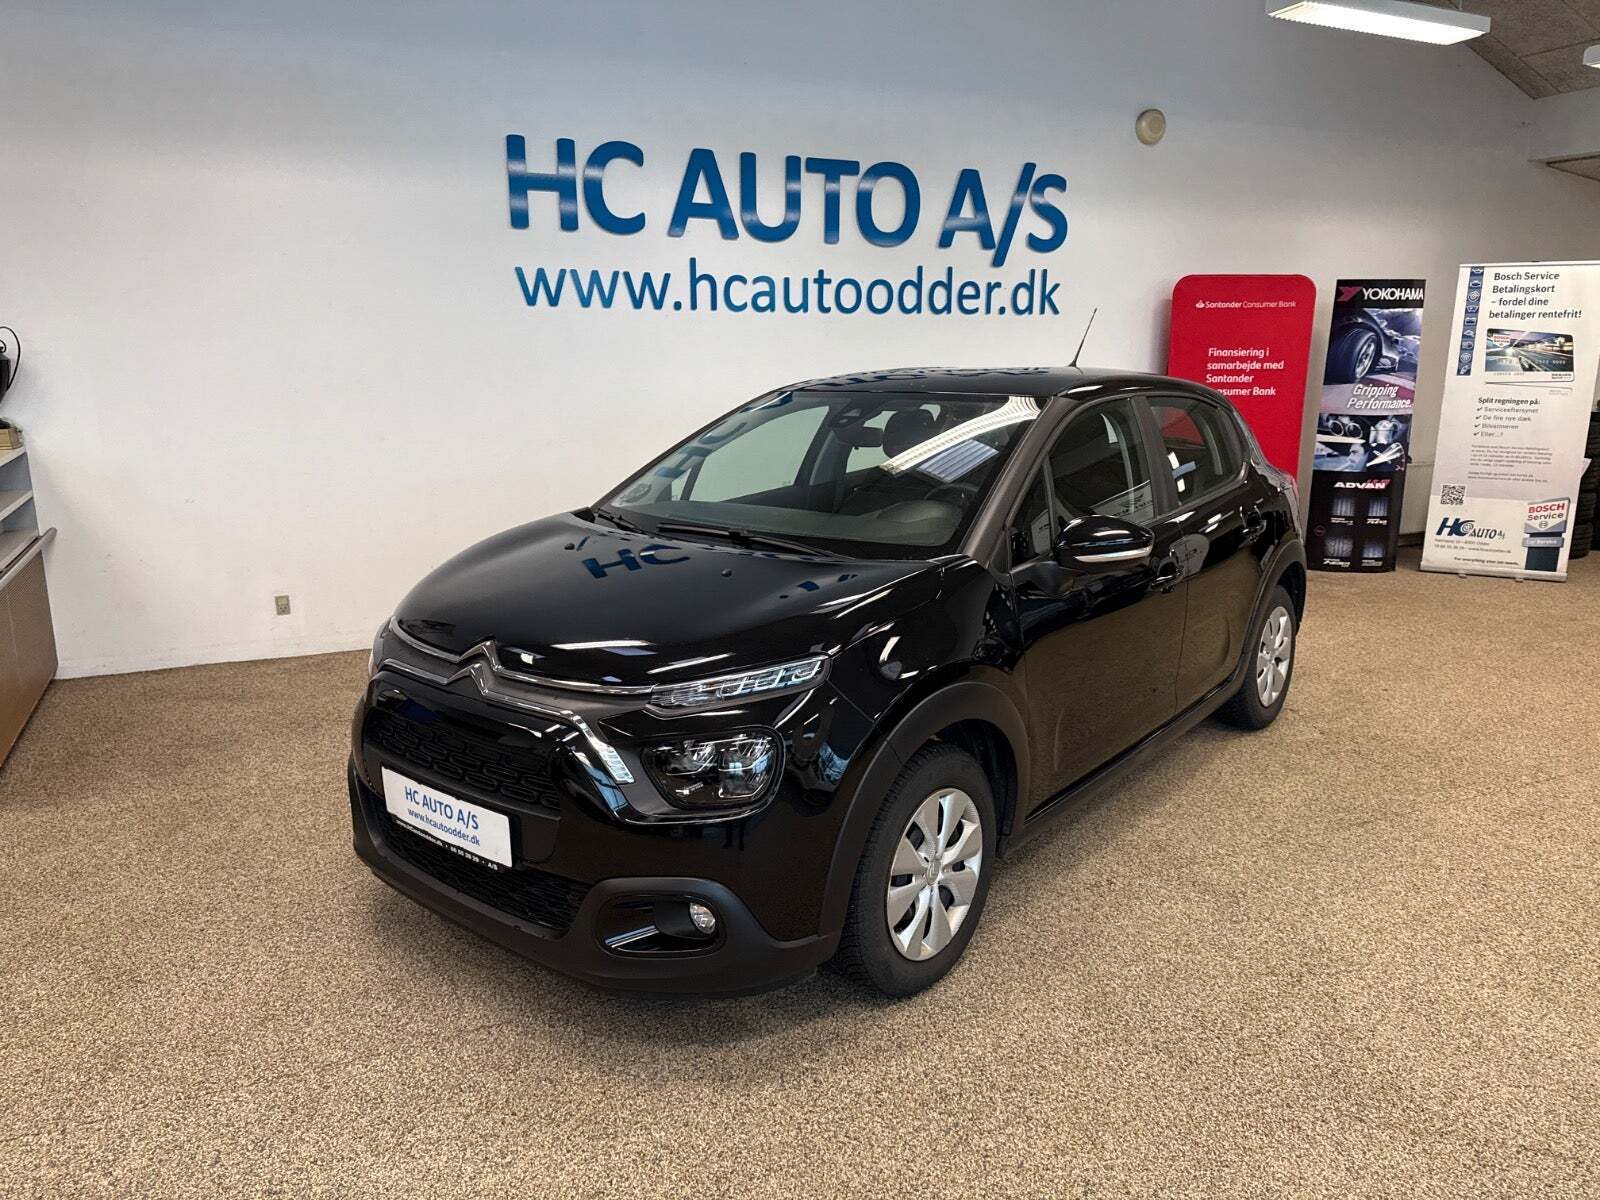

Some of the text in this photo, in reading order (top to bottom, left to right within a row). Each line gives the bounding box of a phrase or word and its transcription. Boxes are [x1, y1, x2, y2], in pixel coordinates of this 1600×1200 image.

[506, 134, 1068, 267] HC AUTO A/S
[1494, 271, 1560, 281] Bosch Service
[515, 257, 1061, 316] www.hcautoodder.dk
[1492, 284, 1555, 295] Betalingskort
[1362, 287, 1424, 300] YOKOHAMA
[1205, 301, 1242, 309] Santander
[1278, 300, 1297, 308] Bank
[1498, 297, 1527, 306] fordel
[1528, 297, 1549, 306] dine
[1489, 309, 1582, 320] betalinger rentefrit!
[1208, 347, 1265, 359] Finansiering
[1207, 360, 1285, 372] samarbejde med
[1206, 373, 1254, 383] Santander
[1252, 386, 1277, 396] Bank
[1353, 383, 1400, 398] Gripping
[1346, 397, 1414, 410] Performance.
[1478, 397, 1494, 405] Split
[1494, 398, 1529, 406] regningen
[1333, 481, 1387, 489] ADVAN
[1528, 503, 1566, 514] BOSCH
[1527, 512, 1564, 521] Service
[1469, 529, 1497, 540] AUTO
[405, 785, 479, 830] HC AUTO A/S
[407, 807, 480, 846] www.hcautoodder.dk
